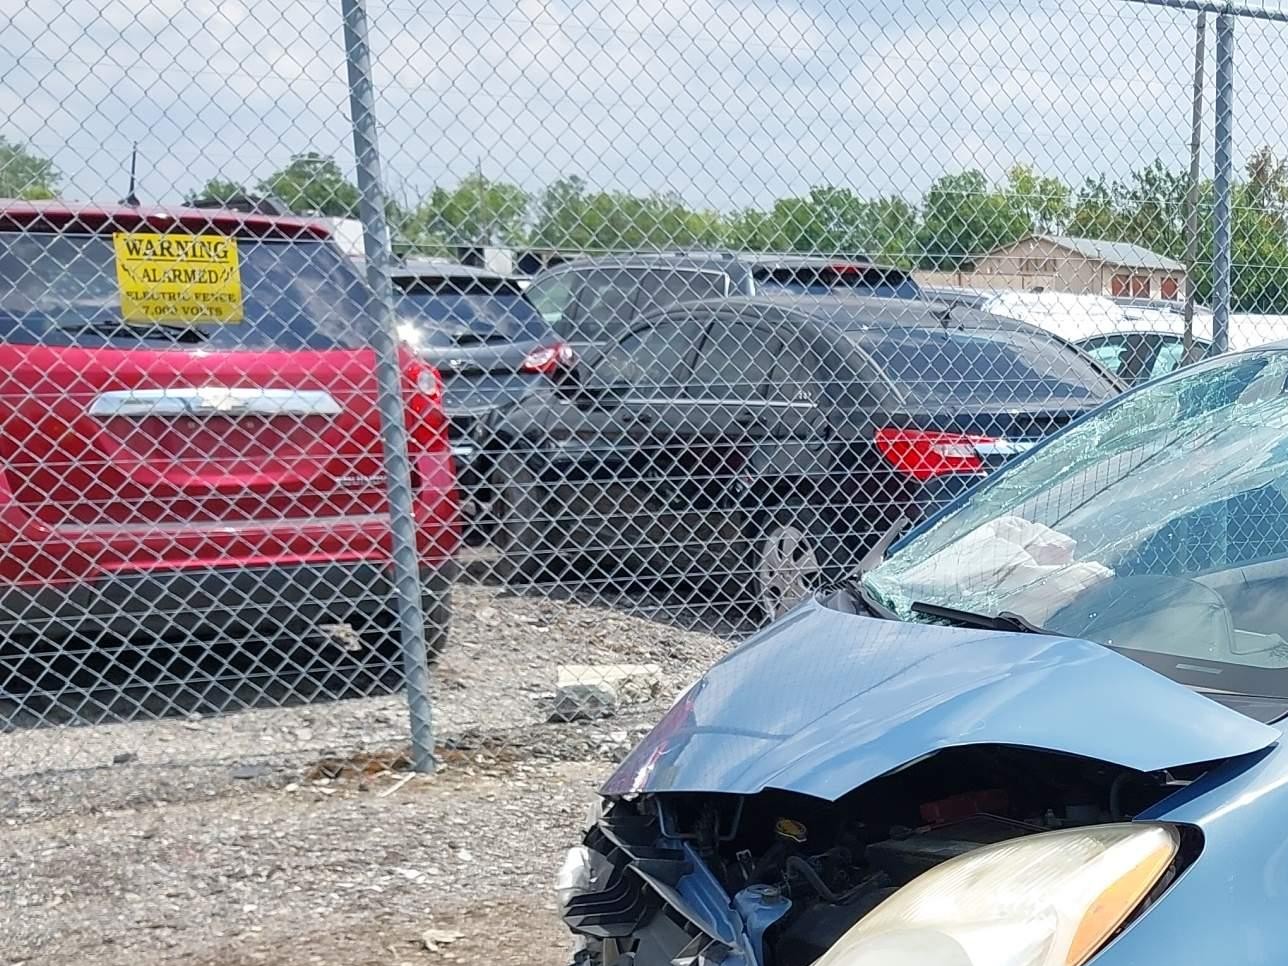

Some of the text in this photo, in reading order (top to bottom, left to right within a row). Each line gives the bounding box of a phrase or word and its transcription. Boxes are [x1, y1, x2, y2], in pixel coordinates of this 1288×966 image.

[123, 238, 229, 260] WARNING
[141, 268, 219, 284] ALARMED
[126, 291, 236, 303] ELECTRIC FENCE
[181, 306, 223, 316] VOLTS
